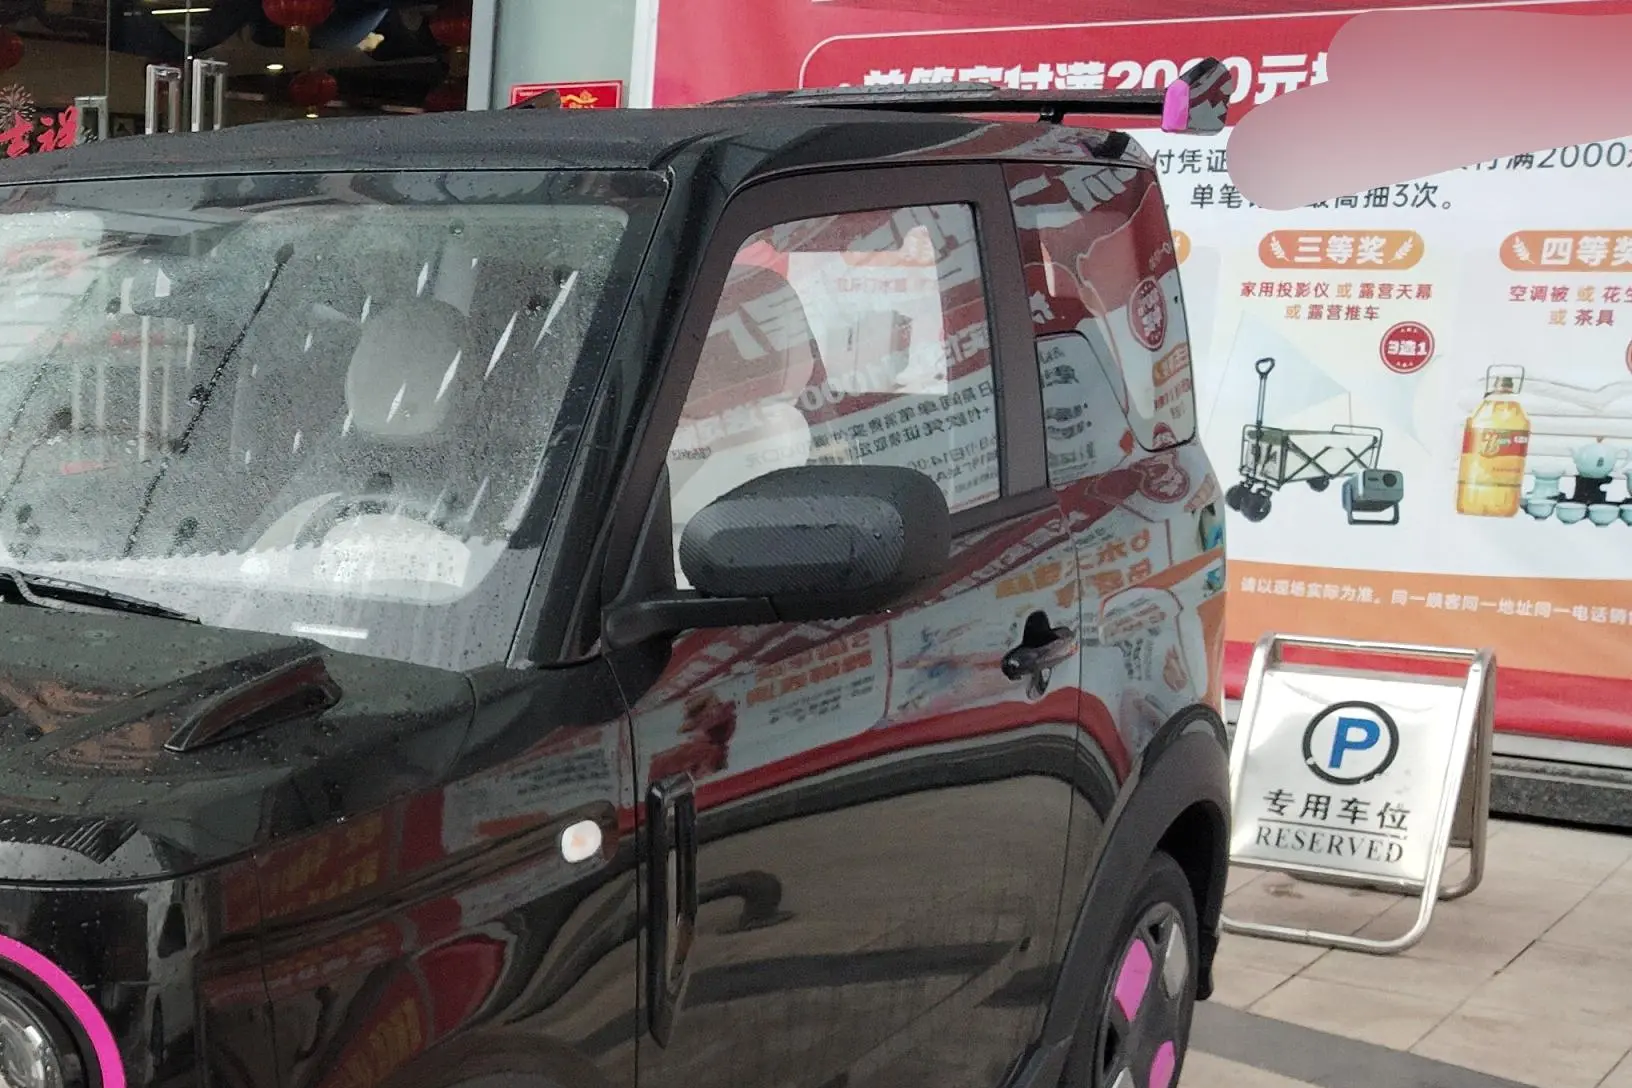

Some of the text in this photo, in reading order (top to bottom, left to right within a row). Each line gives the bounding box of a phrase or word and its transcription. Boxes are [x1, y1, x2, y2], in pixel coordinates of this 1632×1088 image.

[1294, 235, 1387, 265] 三等奖
[1574, 308, 1615, 327] 茶具
[1328, 716, 1381, 769] P
[1262, 788, 1411, 833] 专用车位
[1255, 825, 1404, 863] RESERVED
